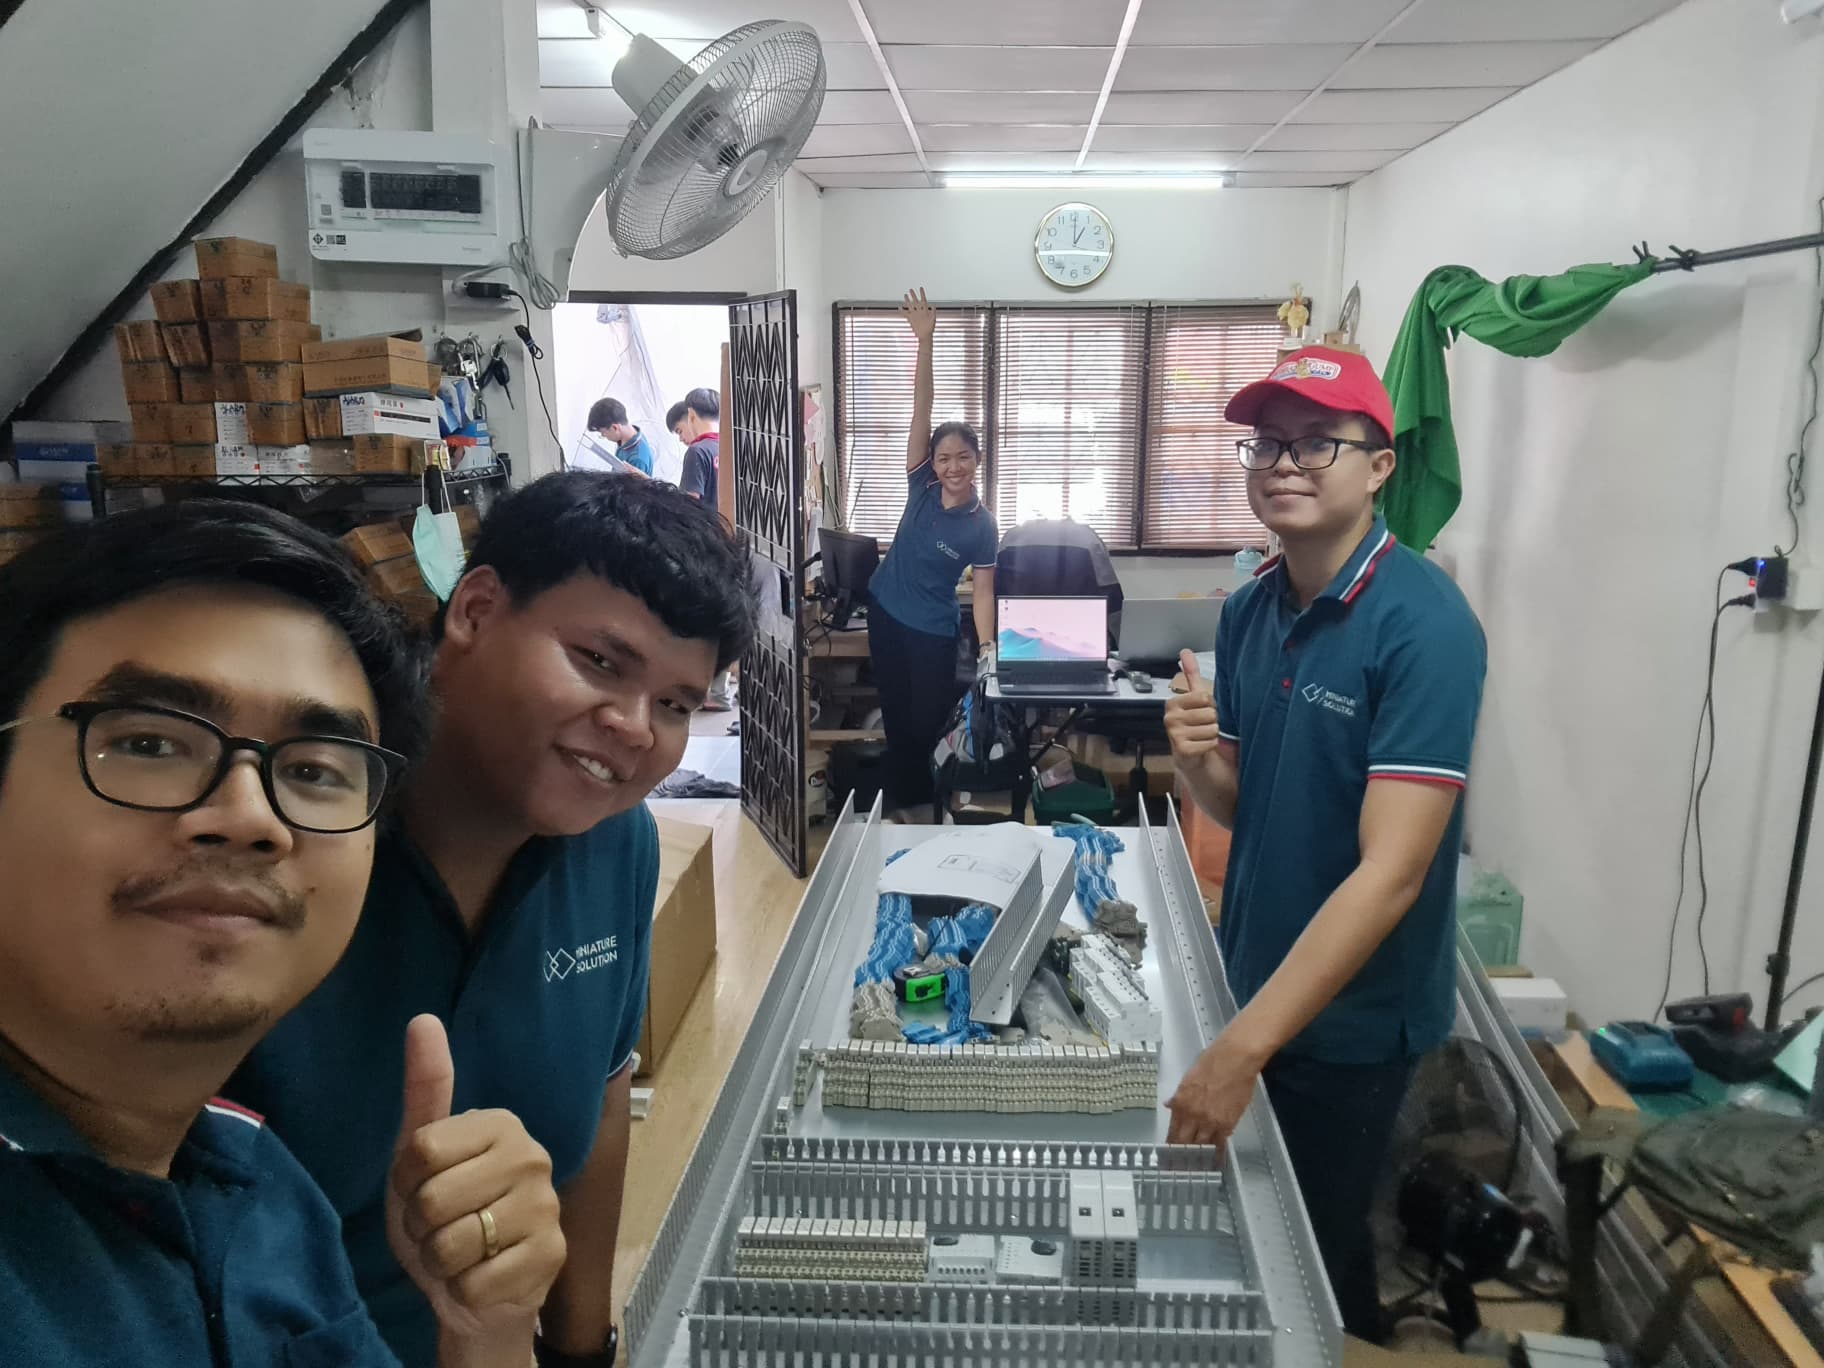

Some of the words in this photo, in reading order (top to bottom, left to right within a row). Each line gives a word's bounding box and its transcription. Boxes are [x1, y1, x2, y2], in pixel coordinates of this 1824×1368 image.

[1058, 216, 1065, 225] 11
[1047, 227, 1058, 237] 10
[1093, 225, 1102, 235] 2
[1044, 241, 1052, 251] 9
[1097, 240, 1105, 249] 3
[1047, 255, 1055, 265] 8
[1092, 255, 1100, 263] 4
[1070, 268, 1079, 279] 6
[1083, 265, 1092, 275] 5
[576, 950, 618, 974] SOLUTION
